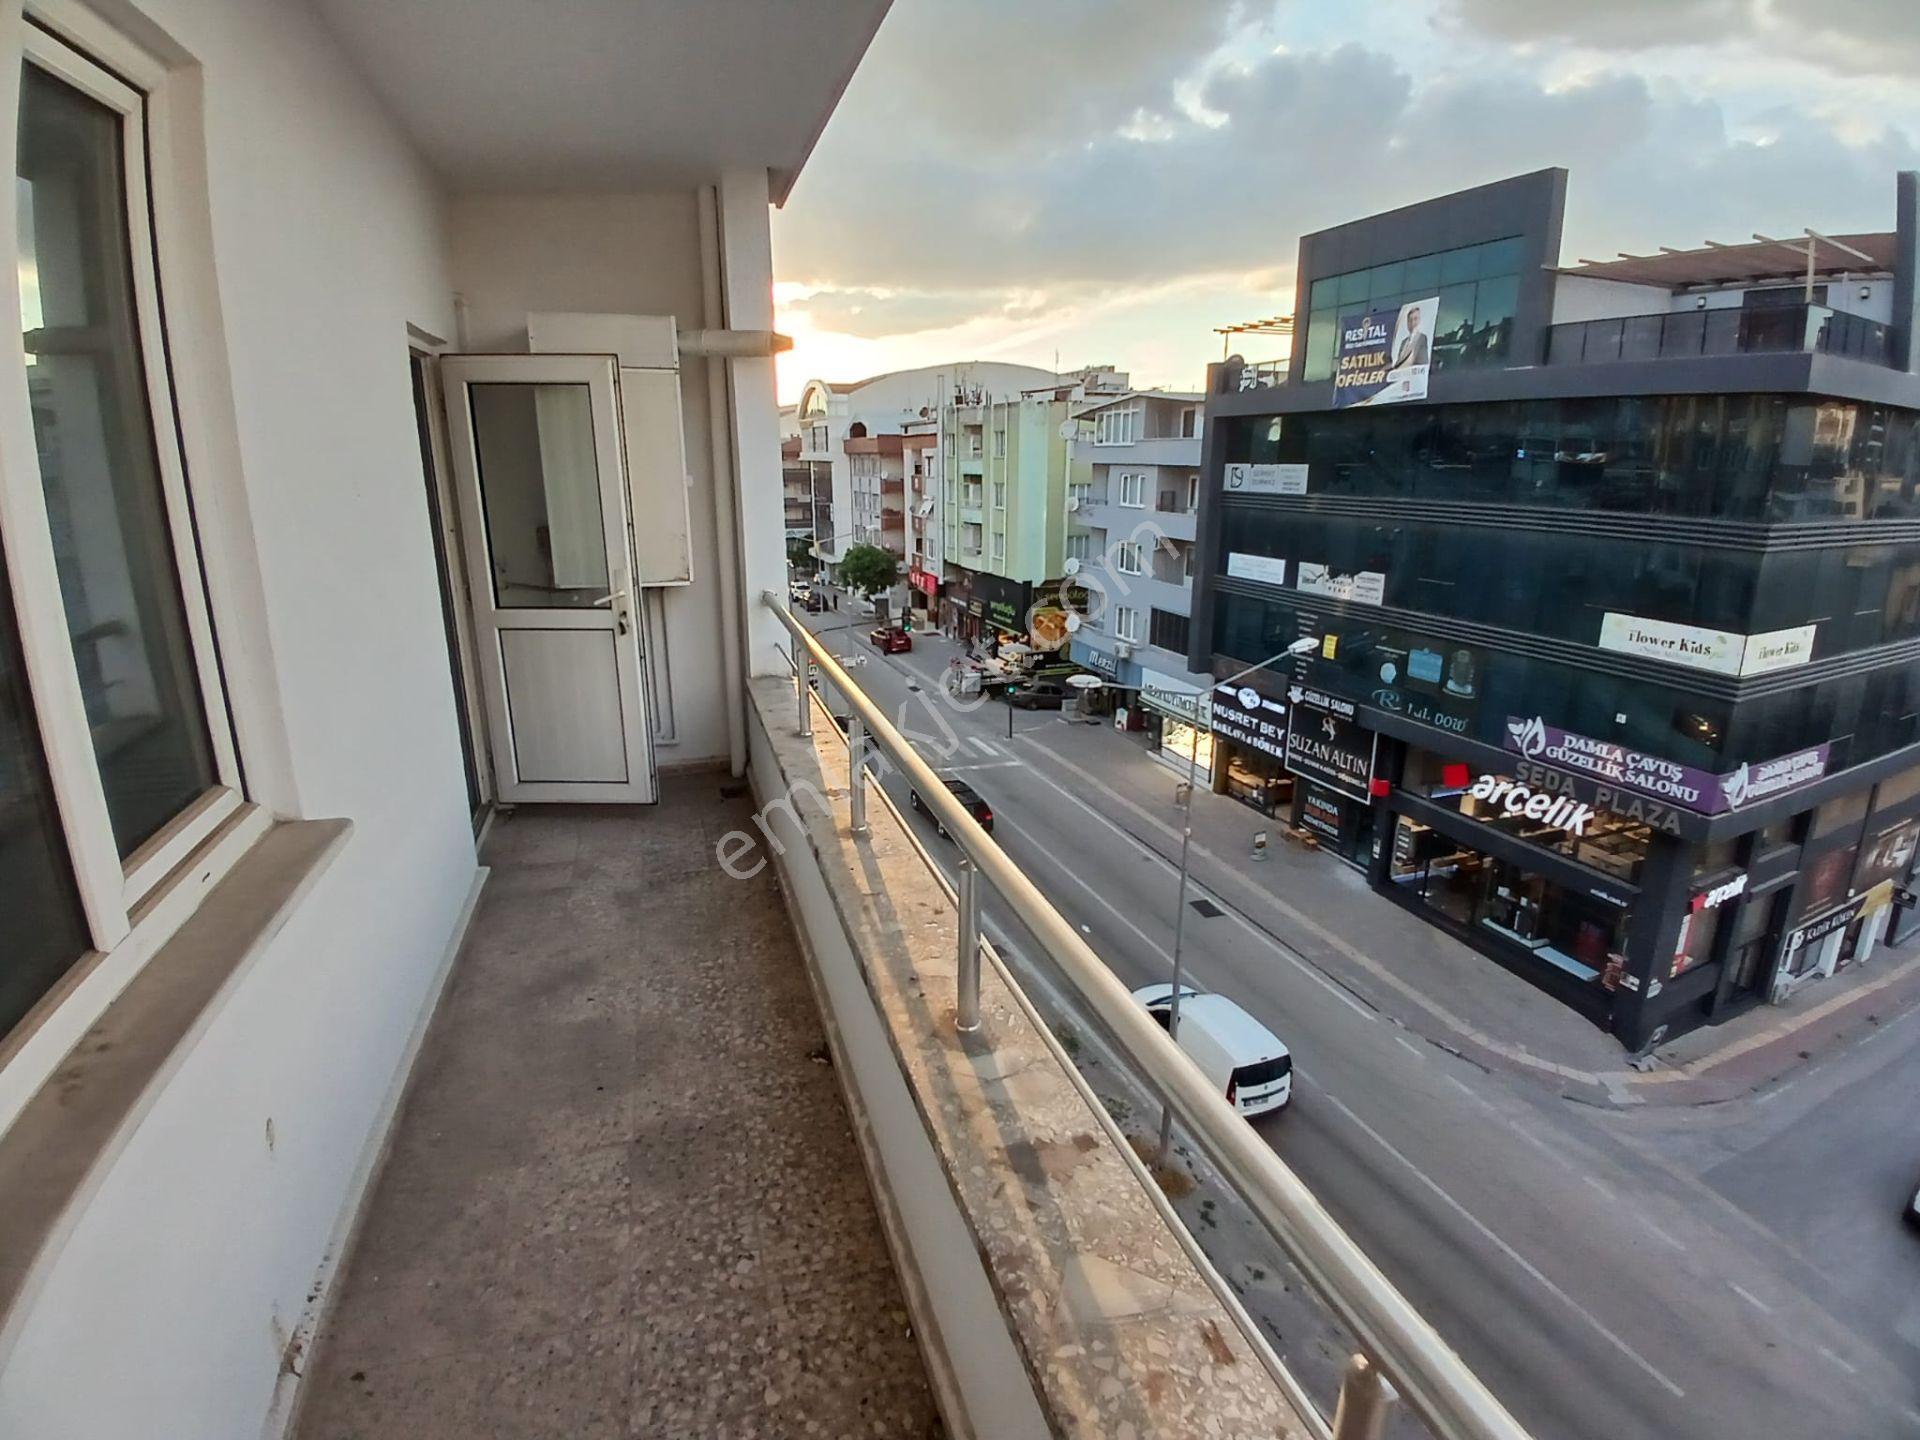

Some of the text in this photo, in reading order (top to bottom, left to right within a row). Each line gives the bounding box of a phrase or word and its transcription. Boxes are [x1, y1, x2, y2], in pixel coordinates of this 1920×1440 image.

[1337, 370, 1386, 388] OFİSLER
[1341, 351, 1386, 370] SATILIK
[1679, 638, 1712, 655] Kids
[1212, 720, 1246, 743] BAKLAVA
[1252, 737, 1283, 759] BÖREK
[1213, 703, 1286, 741] NUSRET BEY
[1289, 733, 1331, 761] SUZAN
[1331, 750, 1368, 777] ALTIN
[1545, 744, 1701, 803] GÜZELLİK SALONU
[1562, 734, 1684, 783] DAMLA ÇAVUŞ
[1515, 760, 1682, 836] SEDA PLAZA
